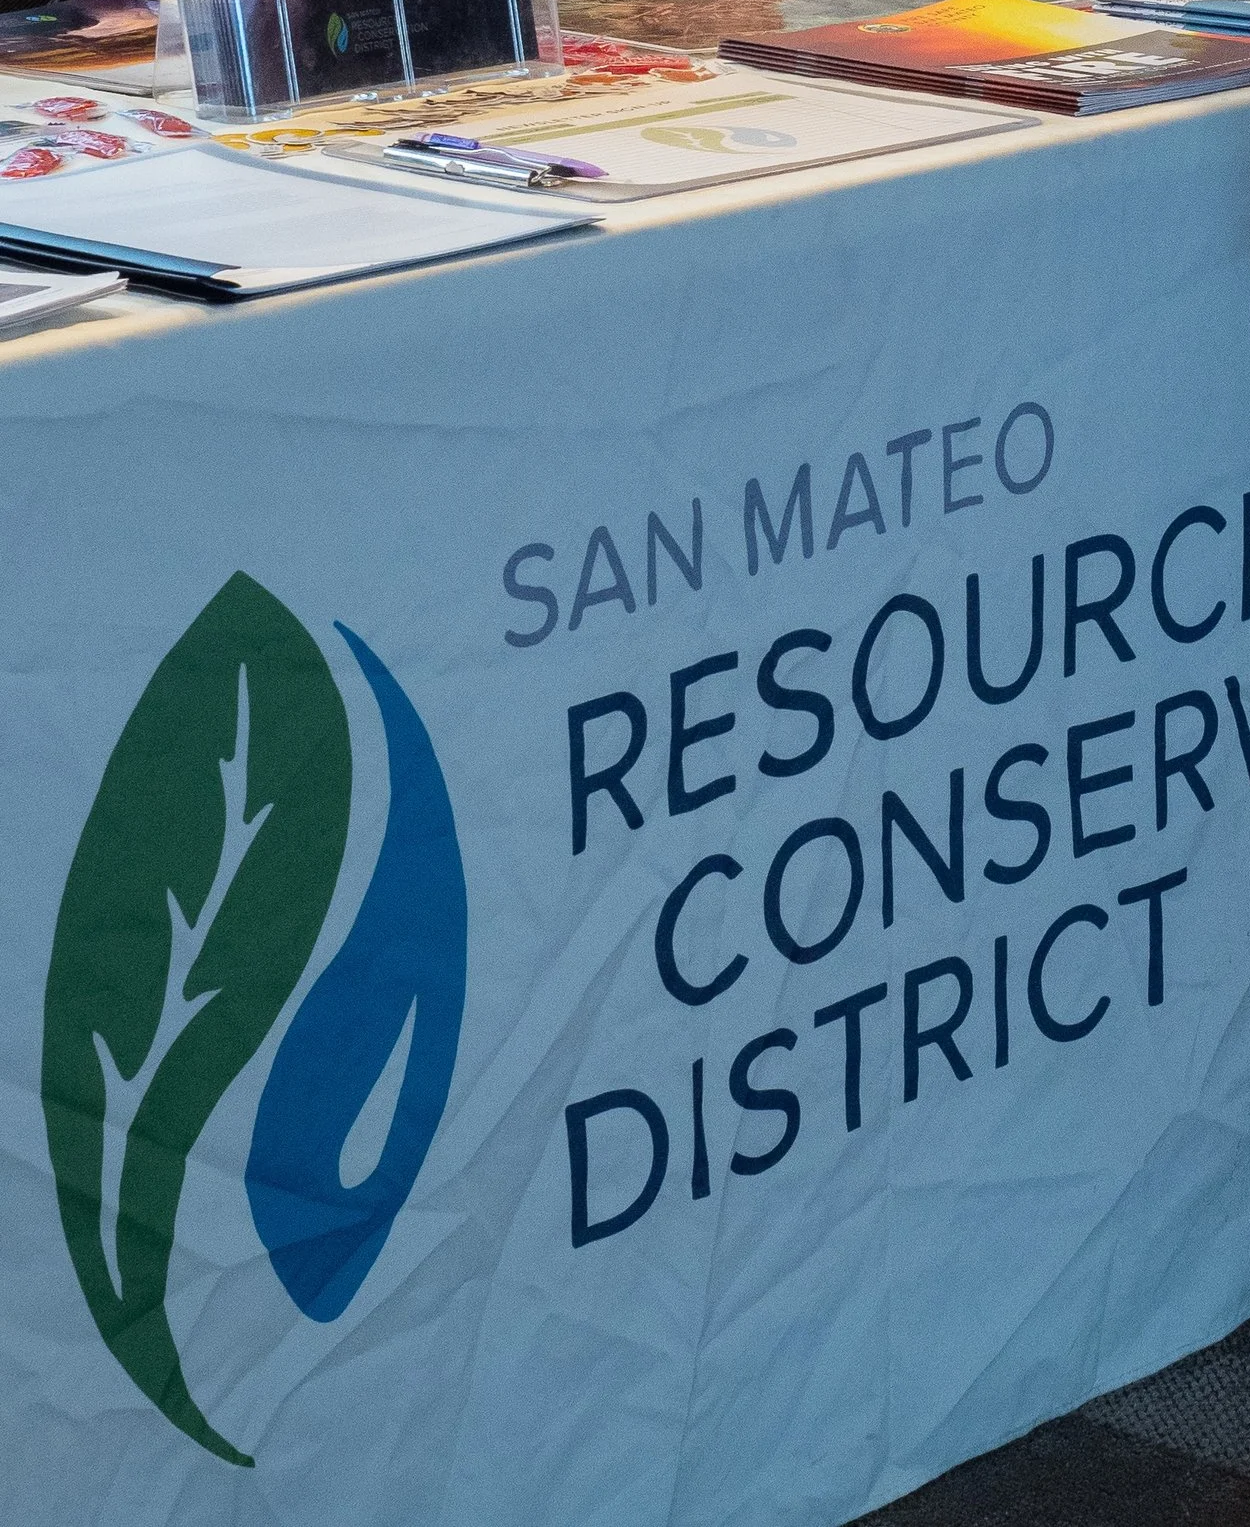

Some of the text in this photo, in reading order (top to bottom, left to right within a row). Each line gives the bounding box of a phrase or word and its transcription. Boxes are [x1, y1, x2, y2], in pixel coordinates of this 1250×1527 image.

[981, 51, 1189, 81] FIRE
[501, 401, 1055, 648] SAN MATEO
[564, 867, 1188, 1249] DISTRICT
